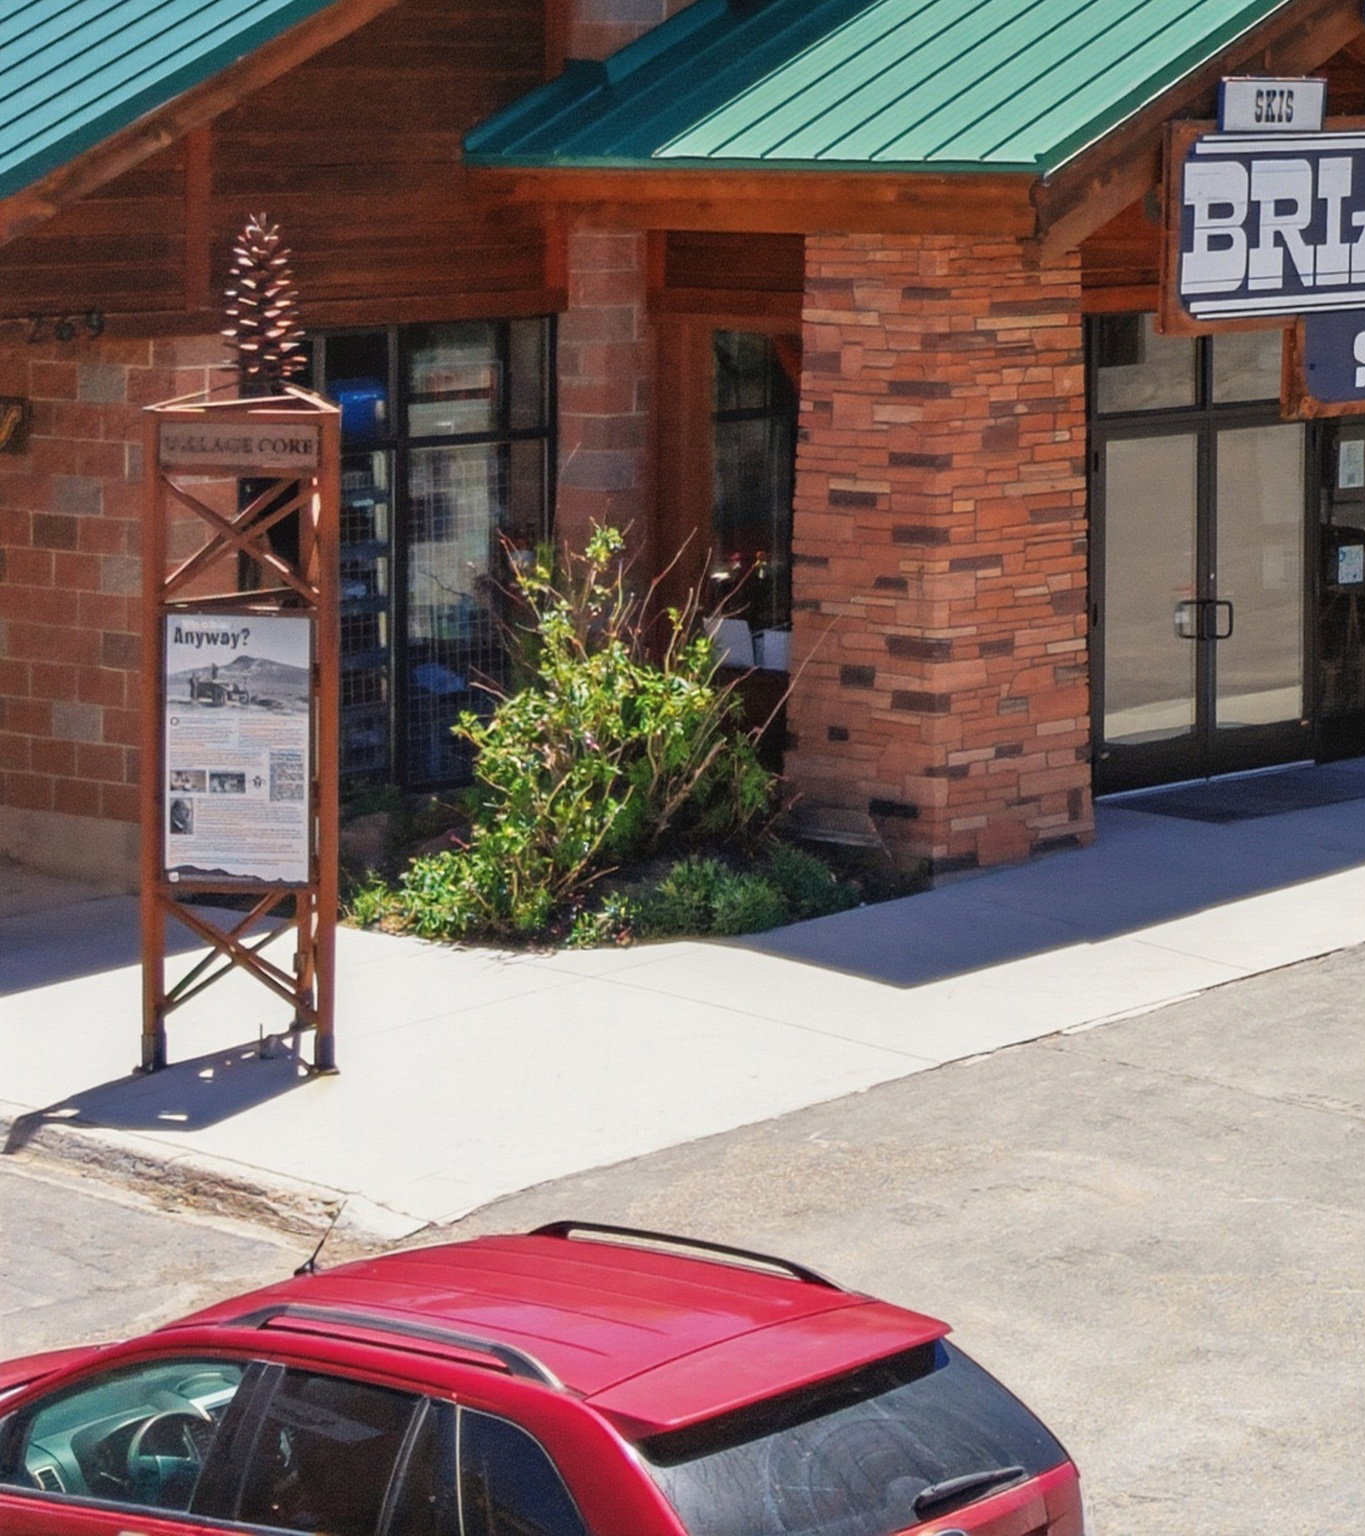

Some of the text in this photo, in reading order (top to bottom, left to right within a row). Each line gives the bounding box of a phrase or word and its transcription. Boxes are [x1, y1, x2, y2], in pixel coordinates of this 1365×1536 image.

[1253, 89, 1295, 124] SKIS
[256, 437, 314, 455] CORE
[173, 626, 251, 650] Anyway?
